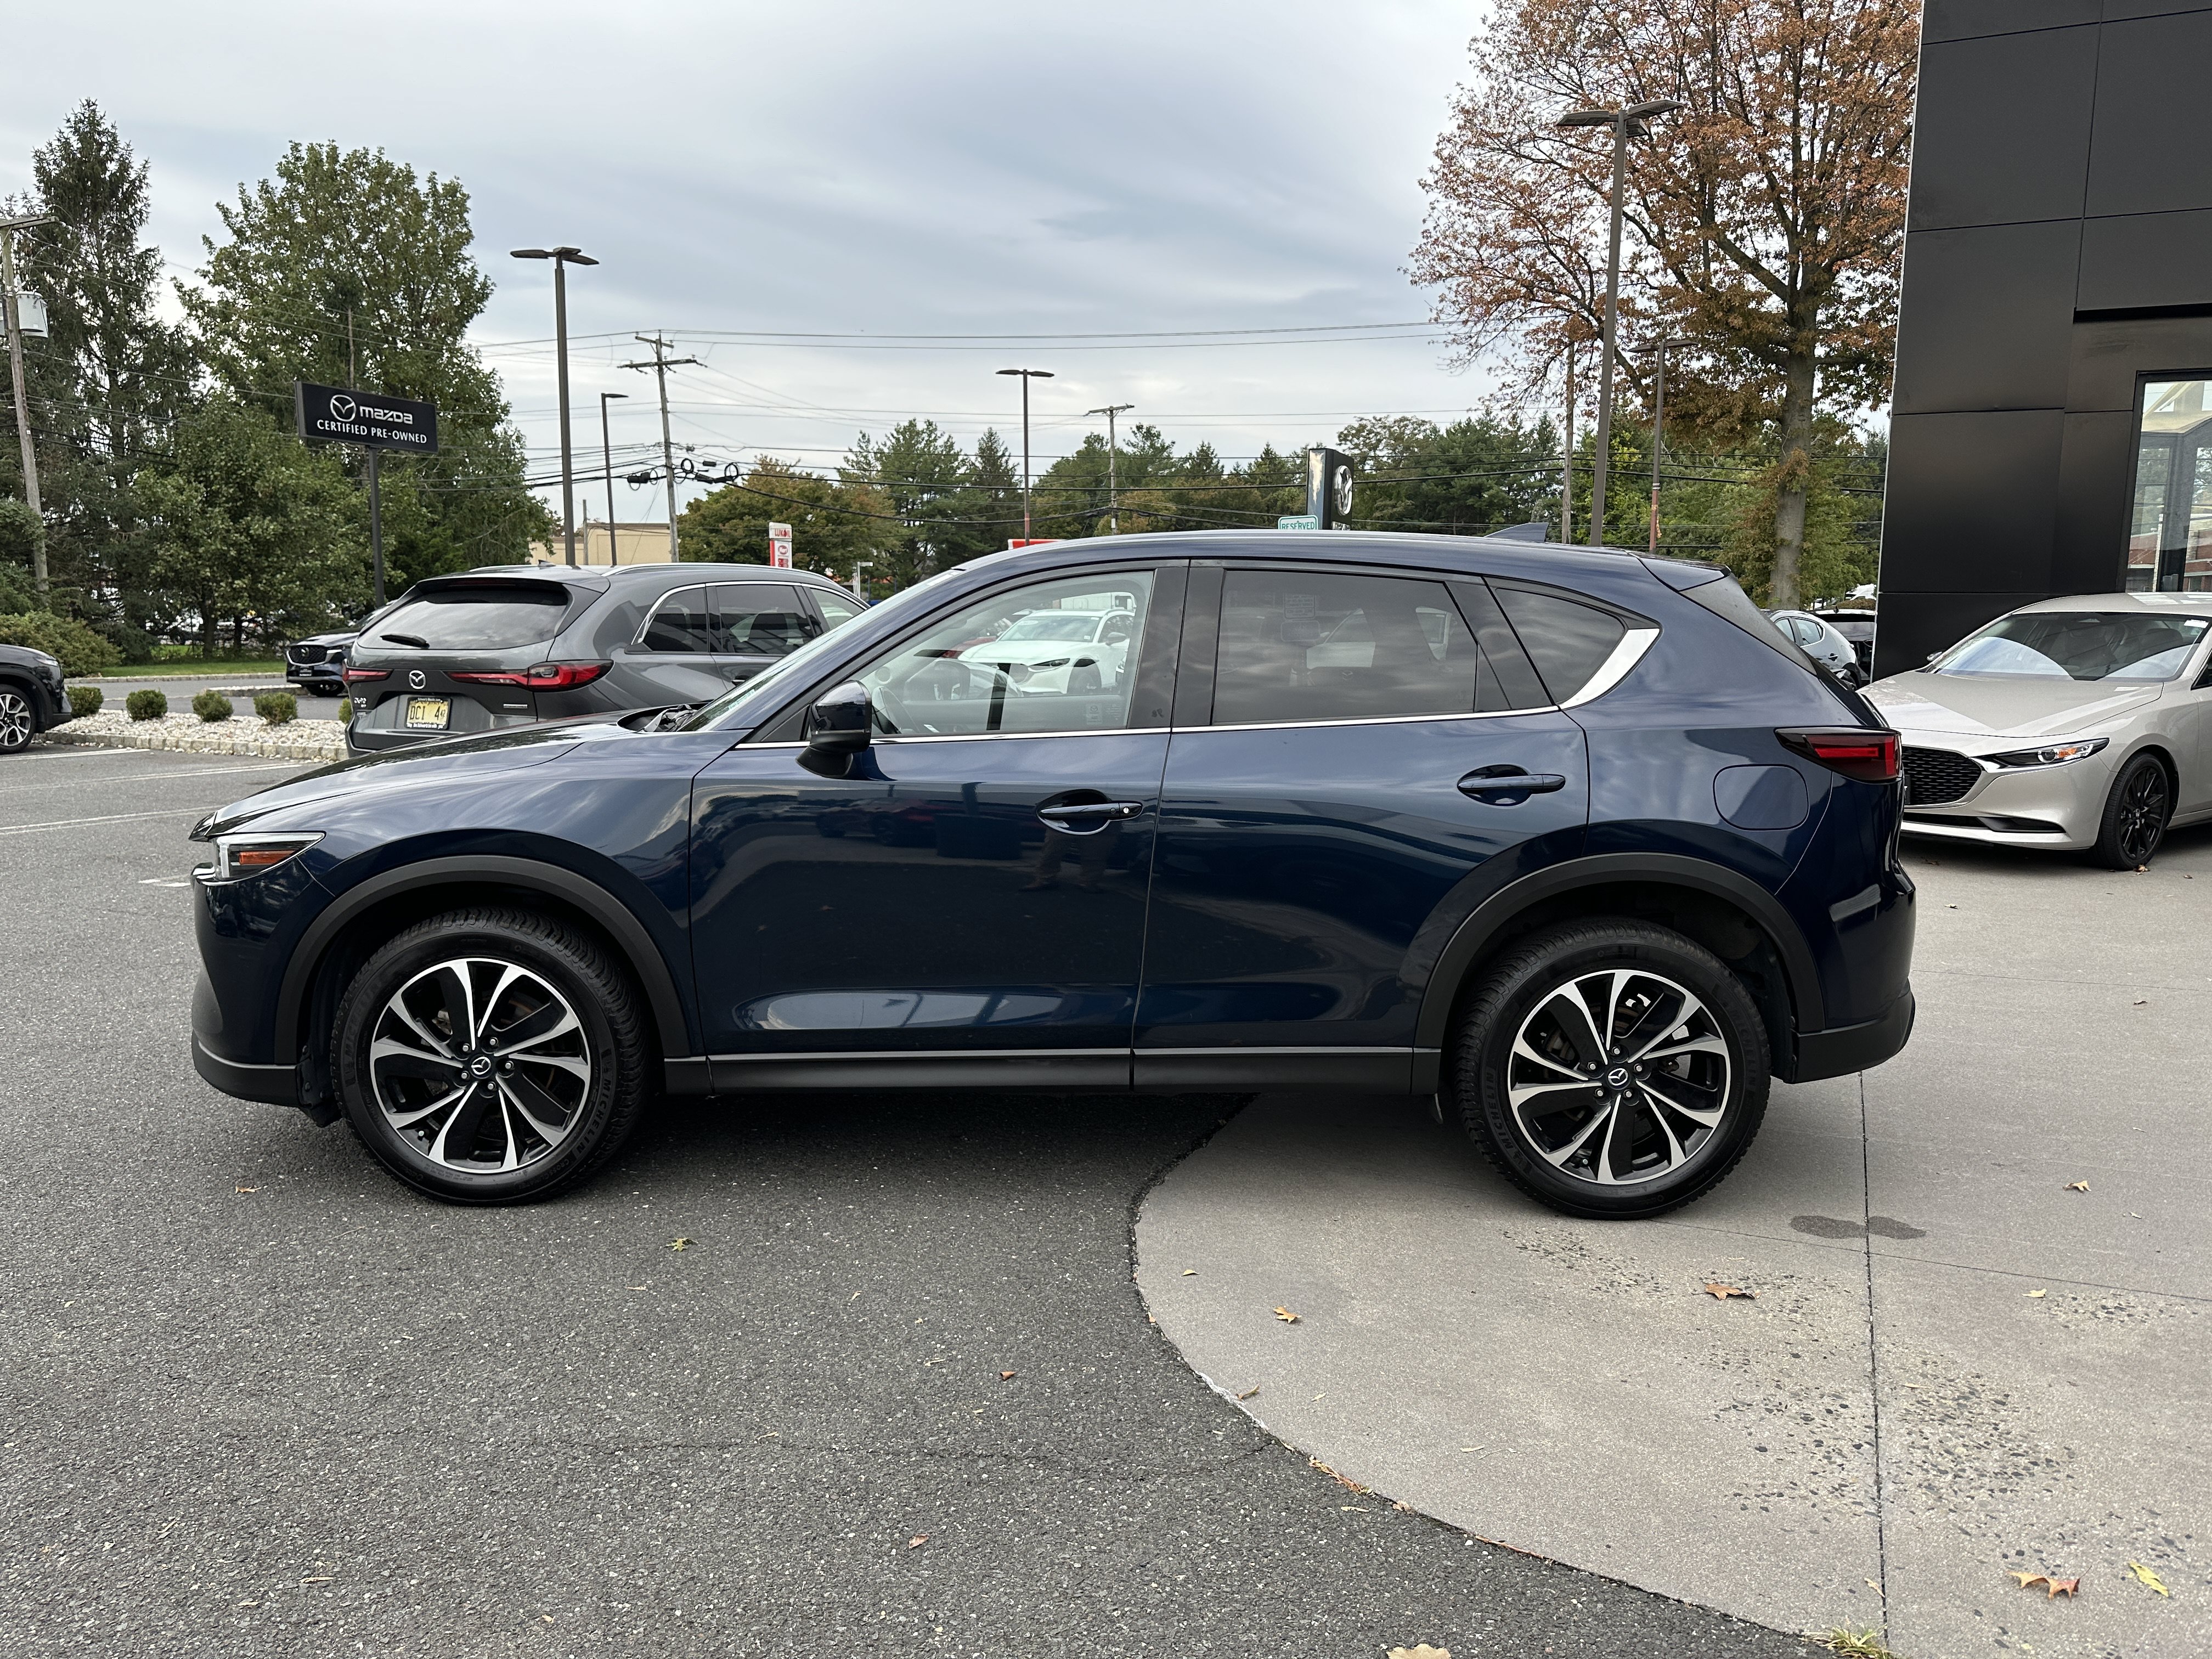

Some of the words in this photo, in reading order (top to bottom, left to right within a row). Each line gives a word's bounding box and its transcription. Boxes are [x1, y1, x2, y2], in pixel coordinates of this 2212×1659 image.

[317, 419, 368, 436] CERTIFIED
[371, 426, 427, 444] PRE-OWNED
[775, 528, 791, 538] LUKOIL
[1282, 522, 1315, 530] RESERVED
[576, 1078, 612, 1154] MICHELIN
[1486, 1072, 1514, 1149] MICHELIN
